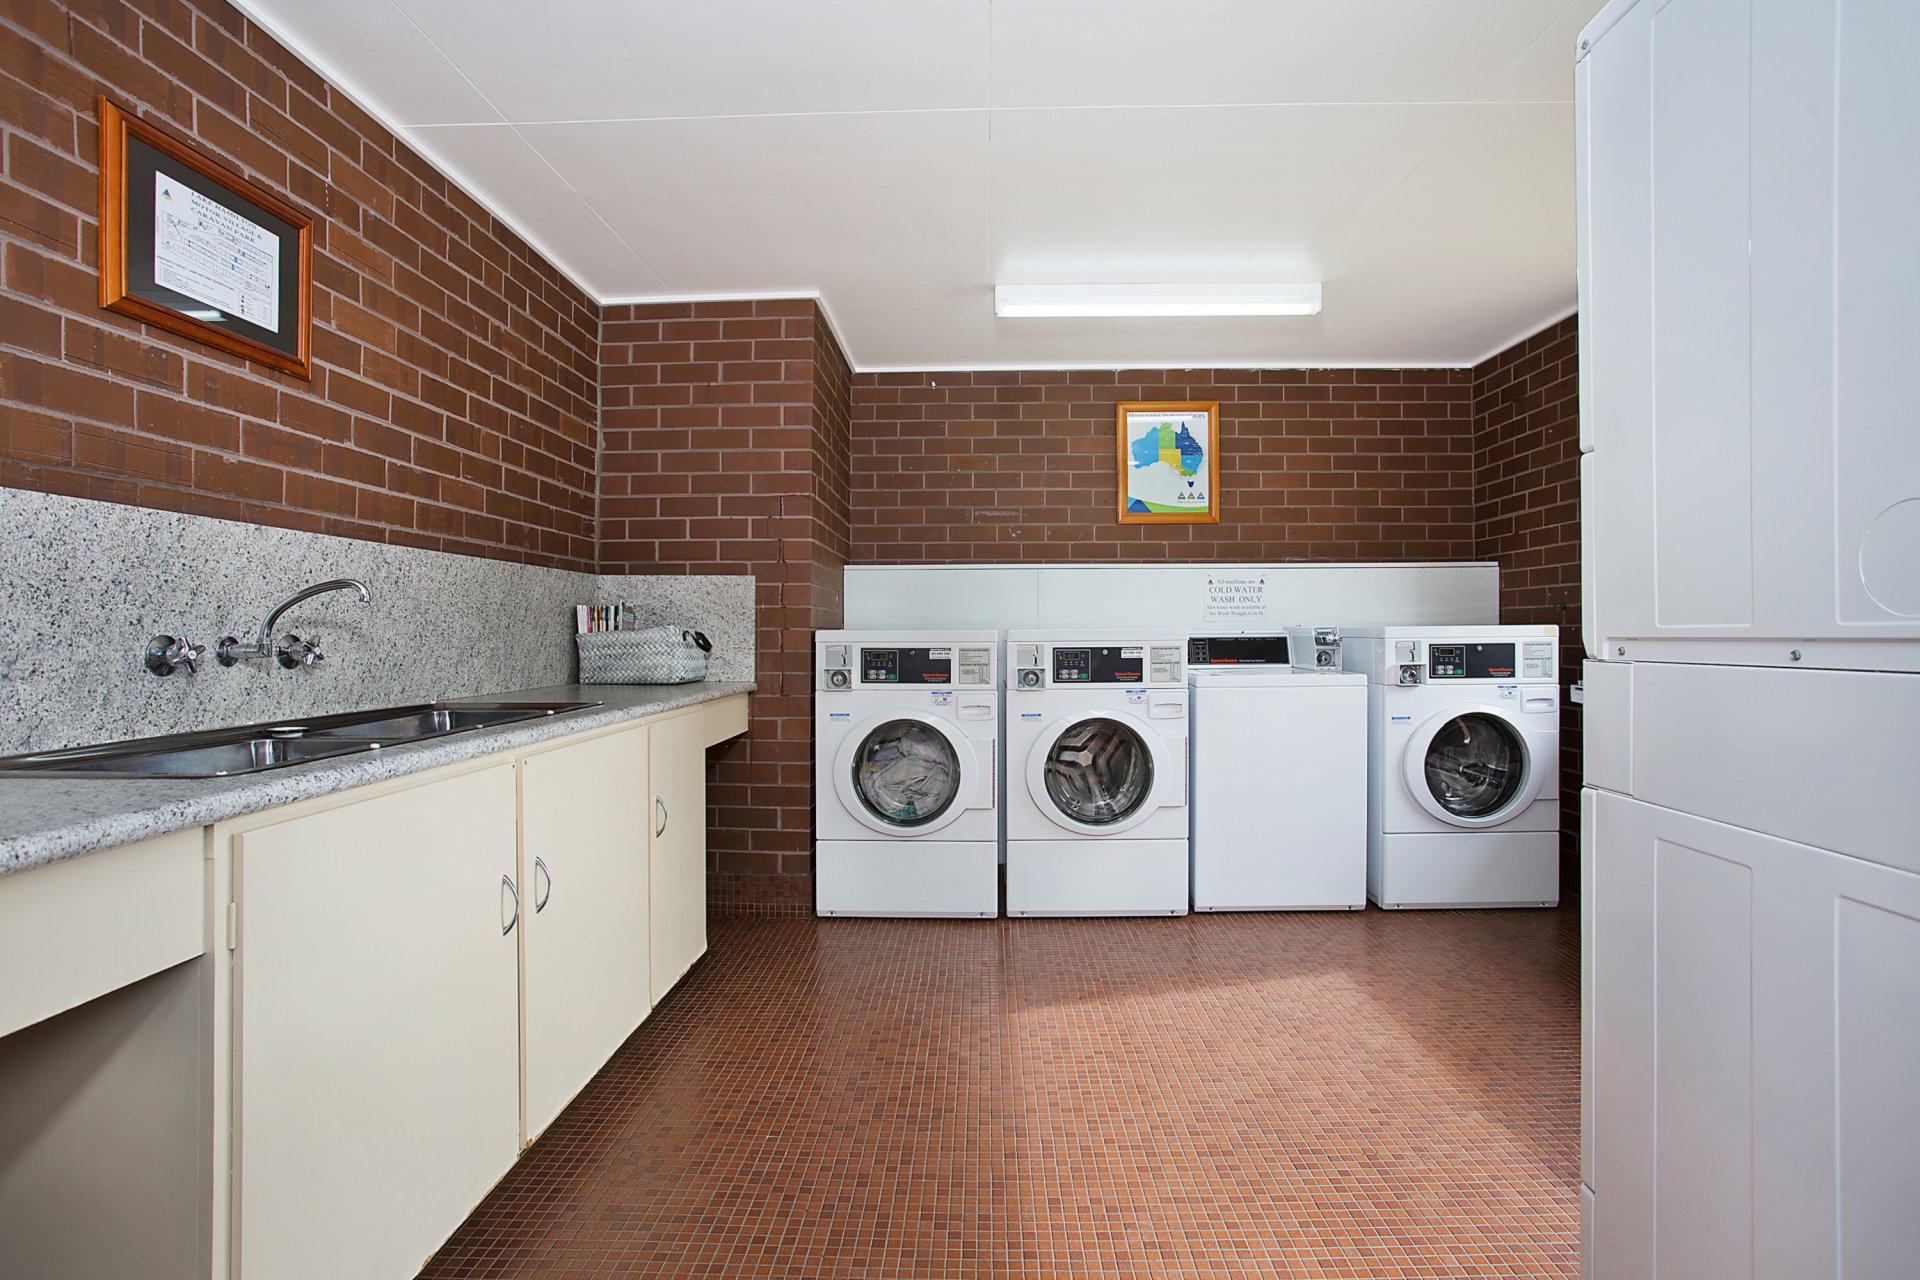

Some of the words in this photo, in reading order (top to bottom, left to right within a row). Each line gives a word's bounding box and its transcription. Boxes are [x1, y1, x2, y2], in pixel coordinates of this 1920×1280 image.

[190, 207, 233, 231] CARAVAN
[233, 229, 256, 243] PARK
[191, 191, 213, 206] LAKE
[214, 203, 257, 230] HAMILTON
[191, 199, 221, 218] MOTOR
[223, 216, 256, 235] VILLAGE
[1208, 586, 1232, 594] COLD
[1233, 586, 1263, 594] WATER
[1210, 595, 1235, 603] WASH
[1238, 595, 1262, 603] ONLY
